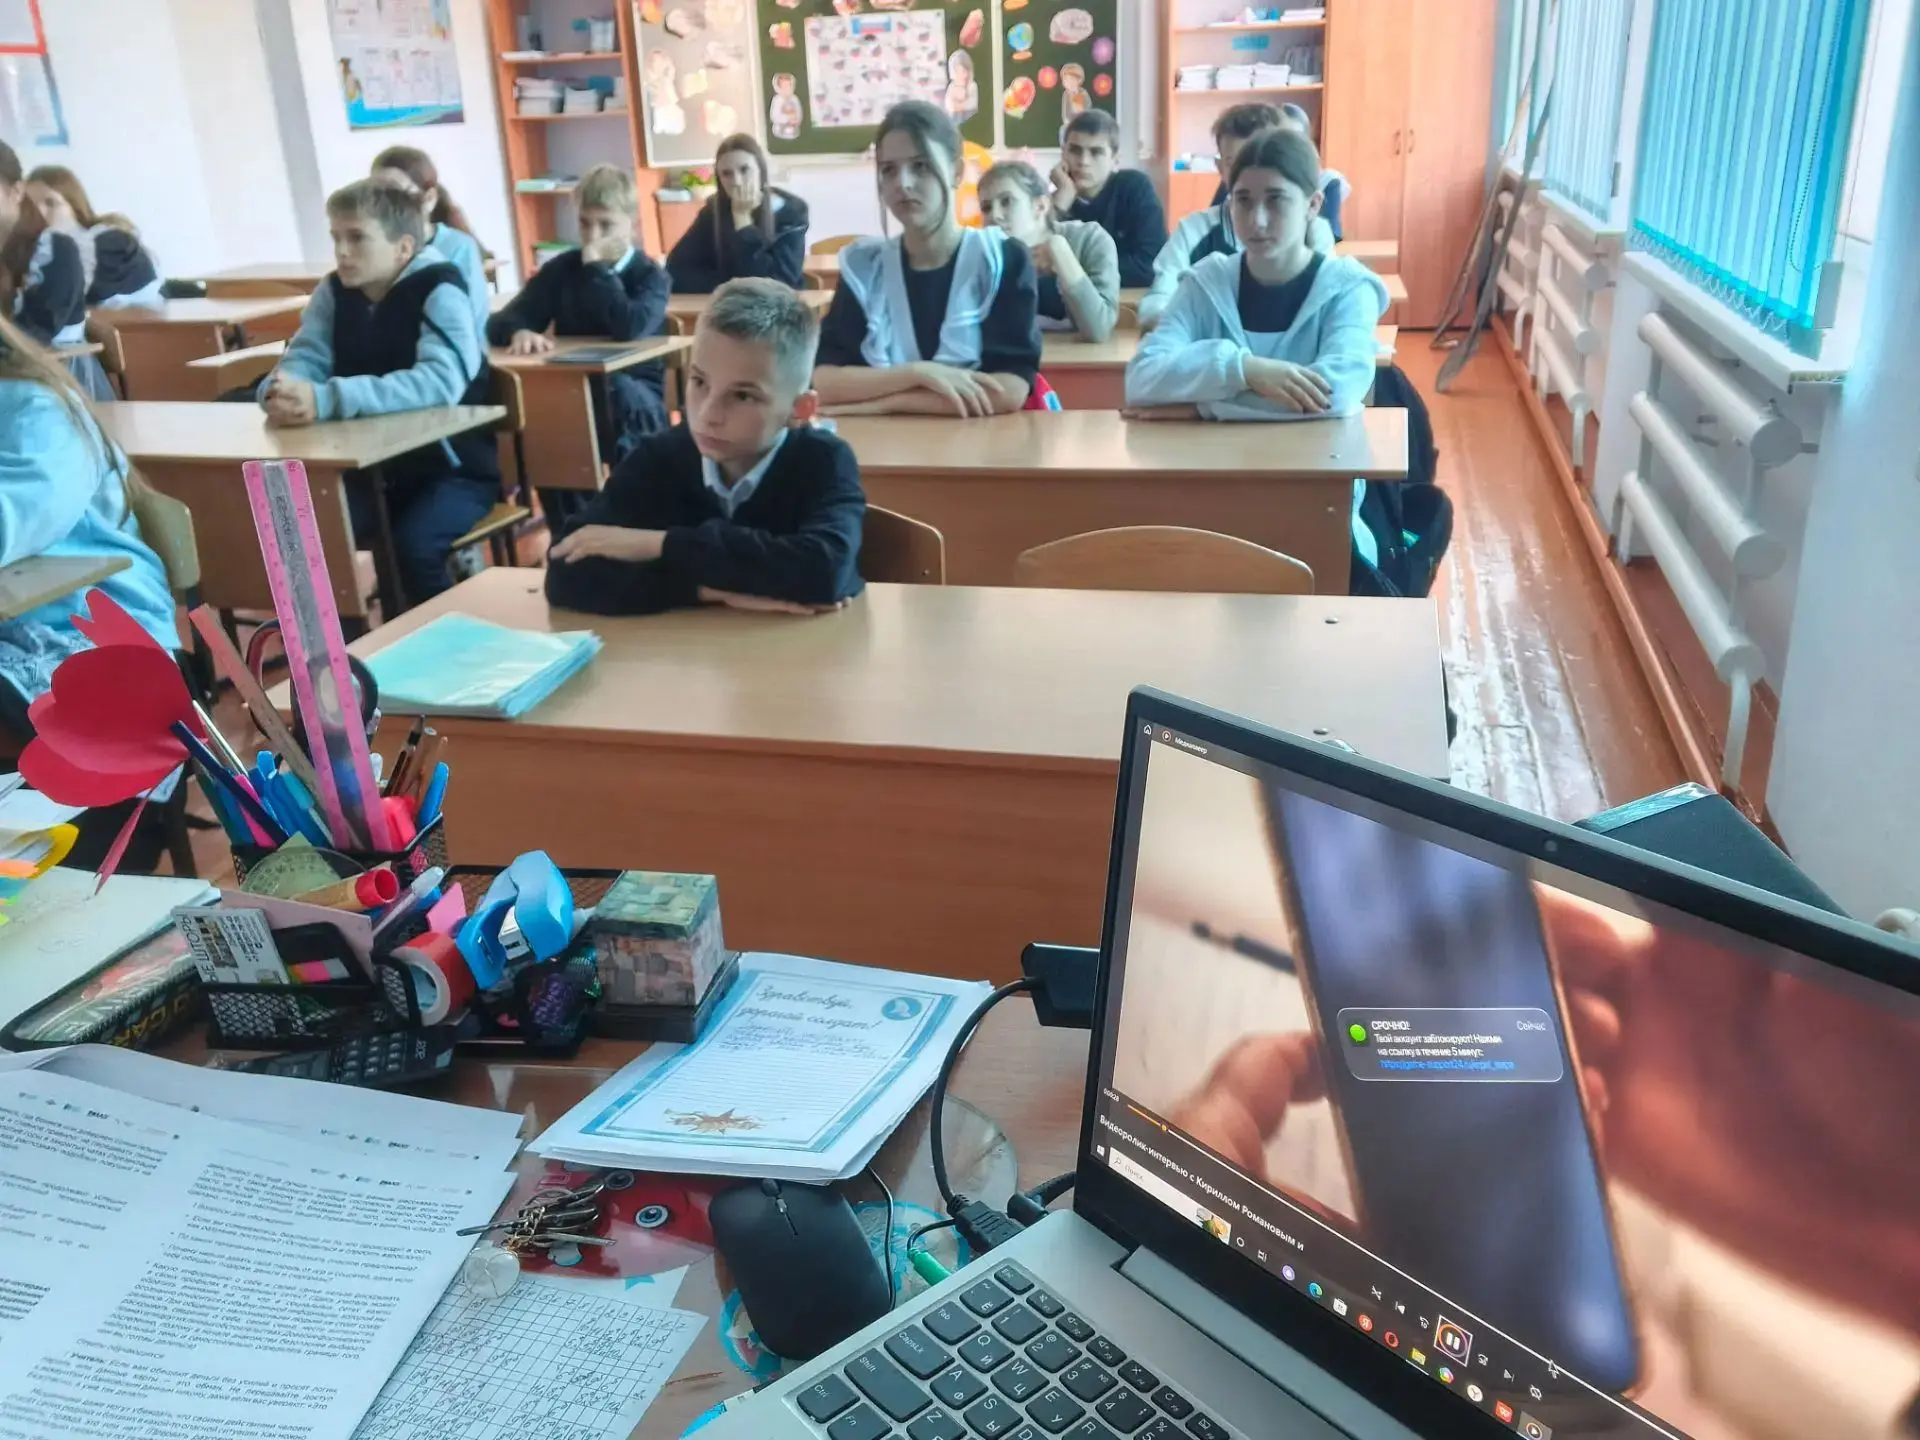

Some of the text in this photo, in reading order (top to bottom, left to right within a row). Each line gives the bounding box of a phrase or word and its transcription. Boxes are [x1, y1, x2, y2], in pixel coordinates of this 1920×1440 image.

[1371, 1021, 1411, 1030] СРОЧНО!
[1516, 1021, 1546, 1031] Сейчас
[1374, 1034, 1392, 1043] Твой
[1394, 1035, 1422, 1045] аккаунт
[1389, 1049, 1415, 1058] ссылку
[1451, 1047, 1458, 1056] 5
[1100, 1115, 1304, 1251] Видеоролик-интервью с Кириллом Романовым и
[939, 1309, 950, 1320] Tab
[899, 1331, 924, 1354] CapsLk
[977, 1334, 991, 1346] Q
[1046, 1334, 1057, 1343] @
[1031, 1344, 1043, 1352] 2
[859, 1357, 878, 1373] Shift
[980, 1354, 993, 1365] Й
[1011, 1361, 1029, 1375] W
[949, 1370, 963, 1381] A
[1067, 1370, 1079, 1380] 3
[814, 1384, 827, 1398] Ctrl
[1013, 1383, 1027, 1395] Ц
[954, 1392, 964, 1400] Ф
[1045, 1390, 1059, 1402] E
[983, 1398, 997, 1410] S
[1105, 1402, 1116, 1410] 4
[845, 1415, 857, 1426] Fn
[926, 1411, 943, 1424] Z
[1051, 1414, 1063, 1423] У
[986, 1420, 1000, 1432] Ы
[1081, 1421, 1096, 1434] R
[1018, 1429, 1033, 1439] D
